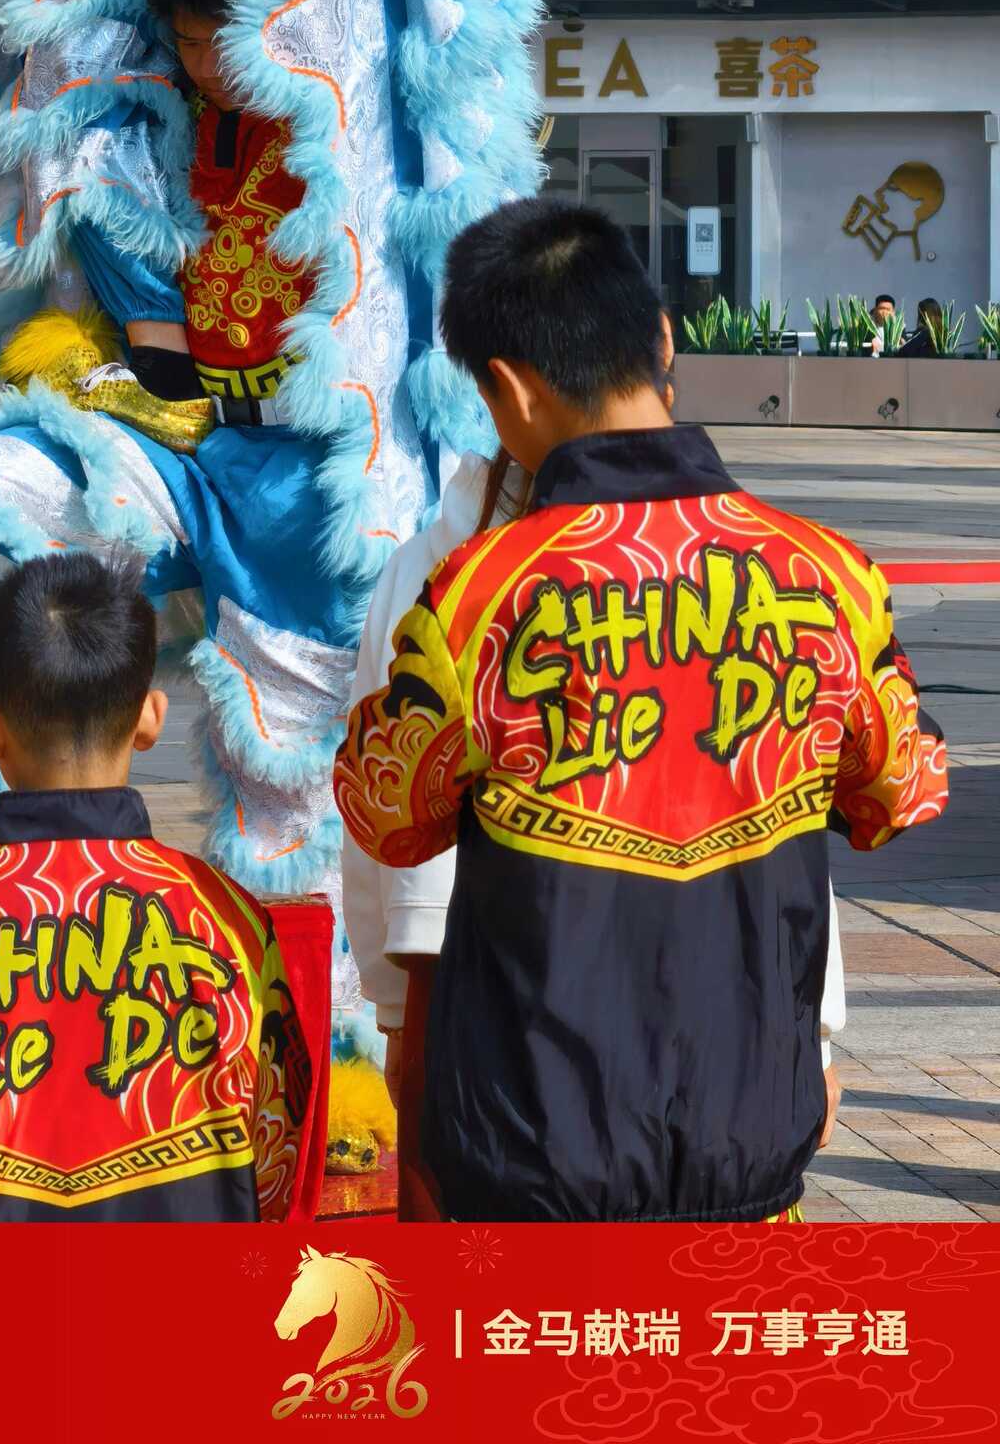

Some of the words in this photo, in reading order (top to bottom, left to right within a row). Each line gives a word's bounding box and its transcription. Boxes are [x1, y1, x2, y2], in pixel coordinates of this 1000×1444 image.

[544, 36, 648, 97] EA
[714, 36, 820, 98] 喜茶
[504, 546, 836, 699] CHINA
[537, 688, 665, 792] Lie
[700, 653, 820, 759] De
[89, 992, 220, 1094] De
